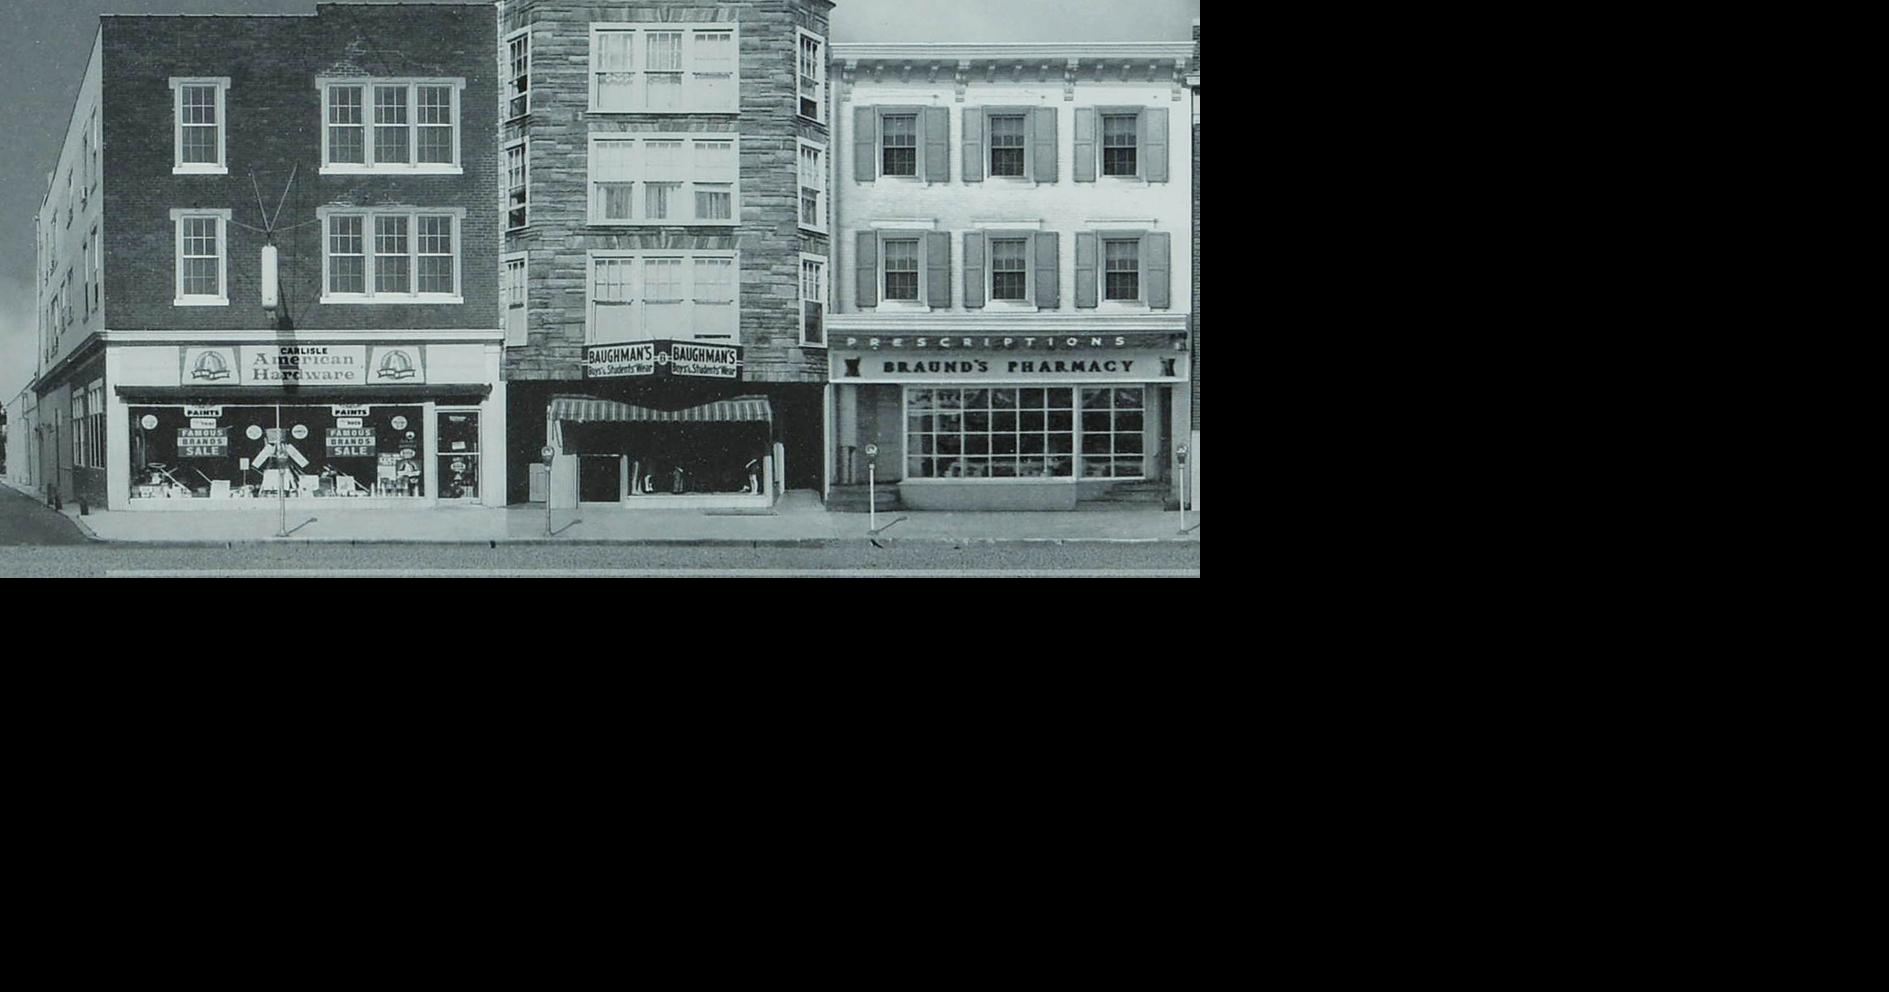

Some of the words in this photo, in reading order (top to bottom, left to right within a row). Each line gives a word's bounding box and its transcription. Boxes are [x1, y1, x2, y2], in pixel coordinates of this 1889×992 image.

[846, 336, 1125, 347] PRESCRIPTIONS
[280, 347, 328, 355] CARLISLE
[589, 345, 652, 364] BAUGHMAN'S
[673, 346, 736, 365] BAUGHMAN'S
[253, 352, 354, 365] American
[883, 359, 989, 373] BRAUND'S
[1007, 360, 1134, 373] PHARMACY
[252, 368, 355, 380] Hardware
[182, 429, 224, 437] FAMOUS
[186, 446, 219, 456] SALE
[334, 446, 367, 456] SALE
